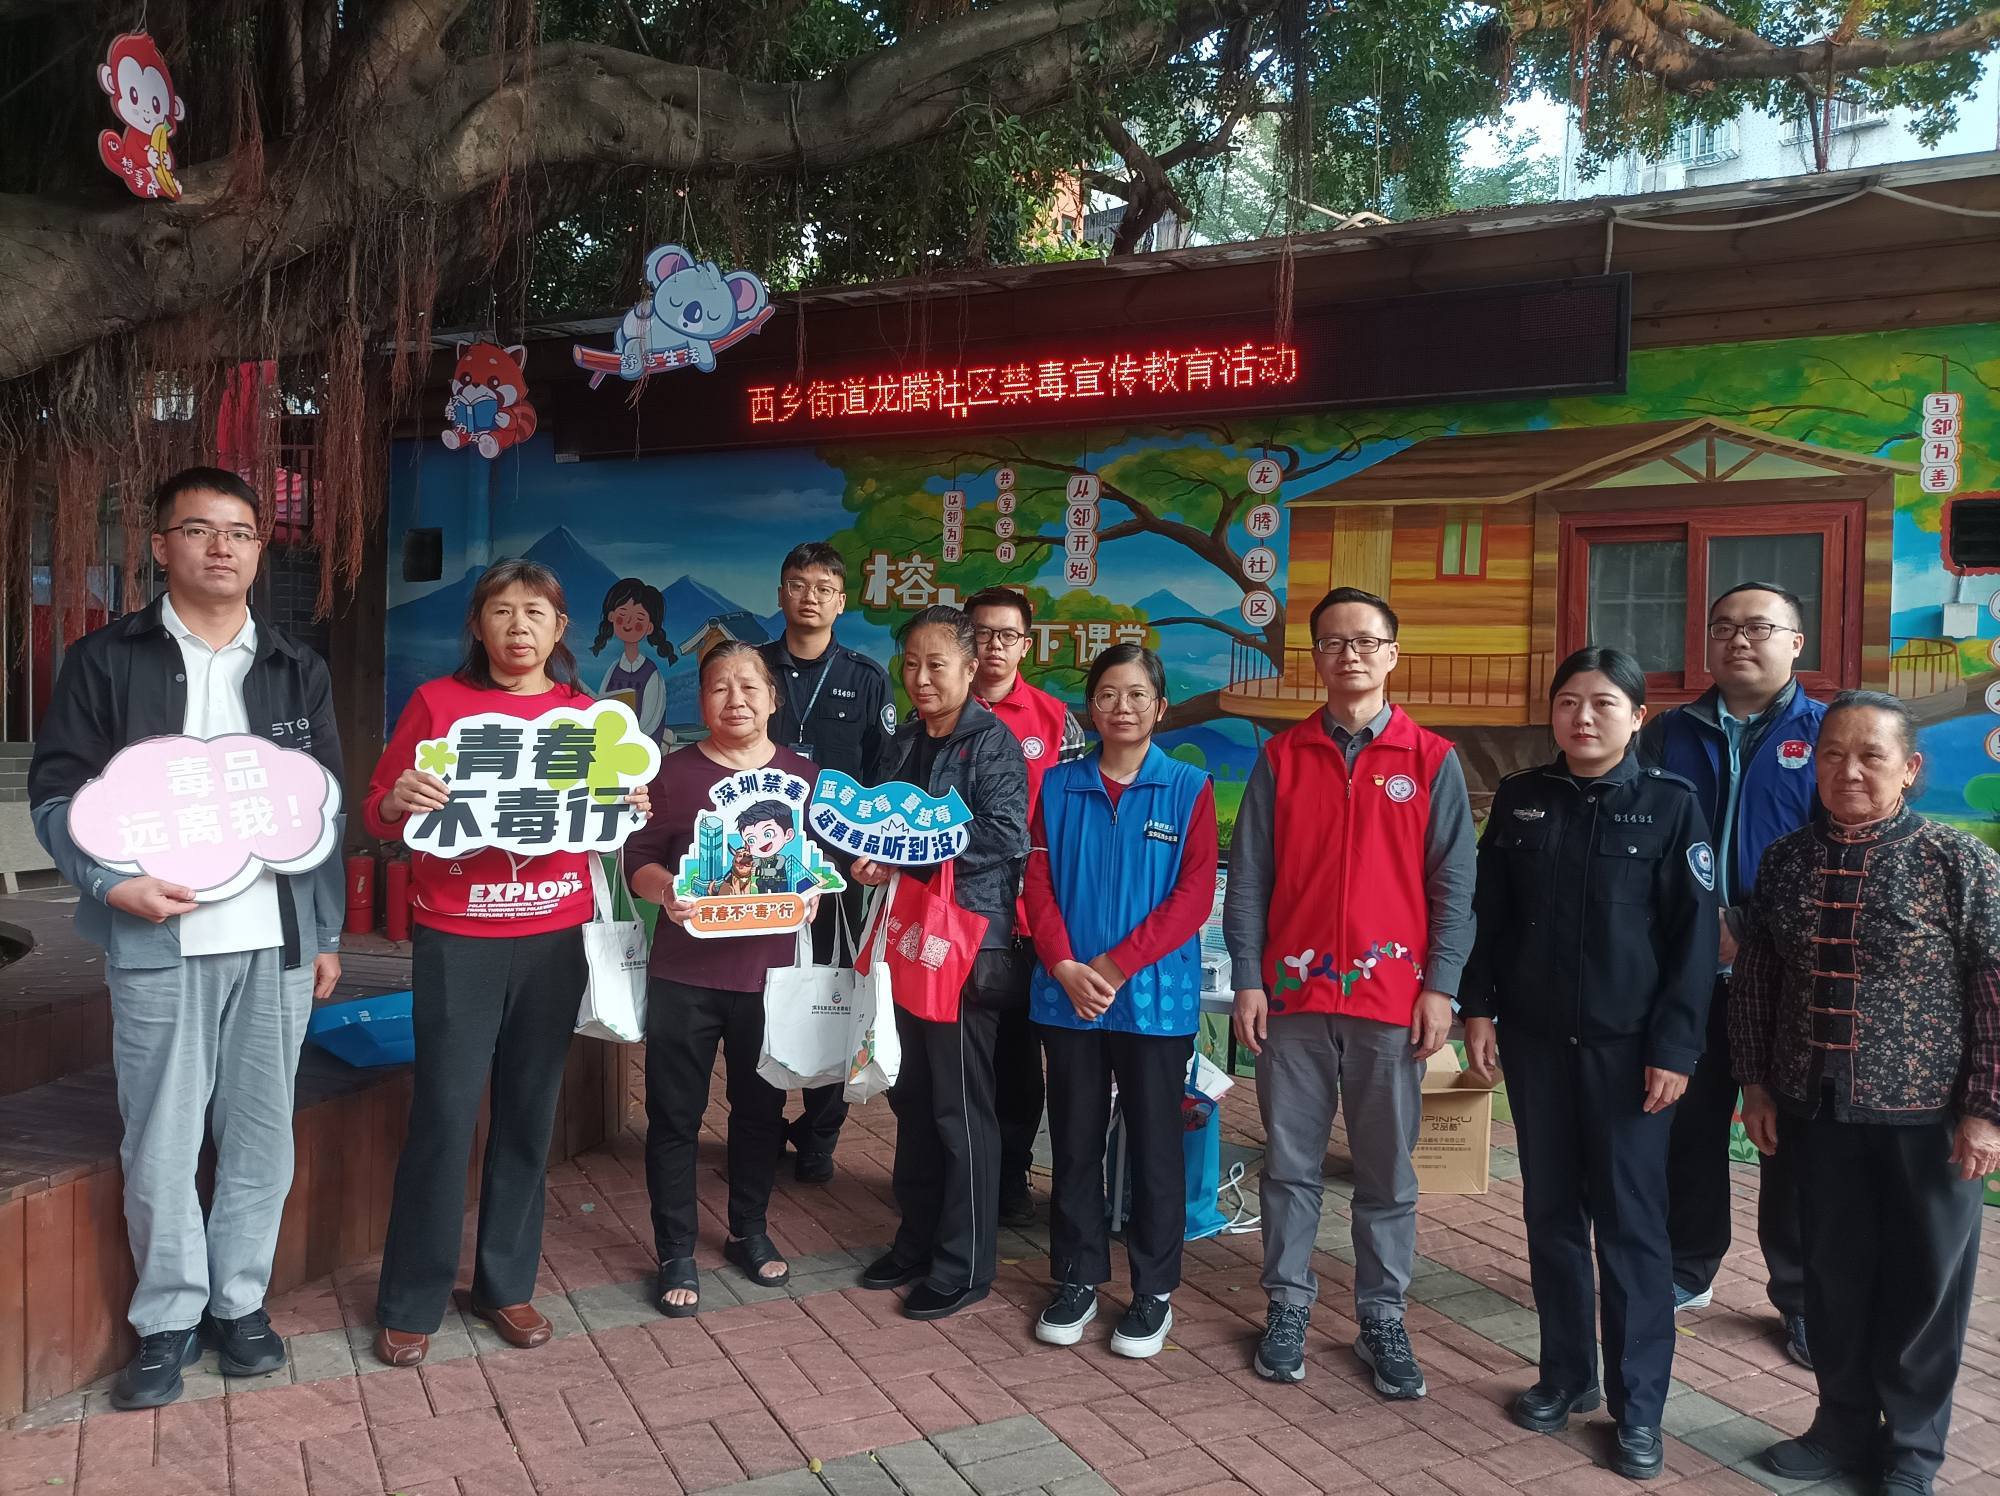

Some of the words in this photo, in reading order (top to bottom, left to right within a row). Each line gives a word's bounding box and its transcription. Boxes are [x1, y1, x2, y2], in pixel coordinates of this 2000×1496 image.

[621, 348, 700, 370] 舒适生活
[748, 343, 1296, 423] 西乡街道龙腾社区禁毒宣传教育活动
[1929, 398, 1952, 487] 与邻为善
[945, 495, 958, 558] 以邻为伴
[1000, 472, 1012, 559] 共享空间
[1069, 479, 1090, 570] 从邻开始
[1248, 467, 1272, 616] 龙腾社区
[166, 749, 269, 797] 毒品
[455, 724, 597, 781] 青春
[412, 787, 631, 847] 不毒行
[715, 773, 805, 807] 深圳禁毒
[118, 795, 303, 854] 远离我！
[815, 809, 963, 862] 远离毒品听到没！
[699, 903, 794, 922] 青春不“毒”行
